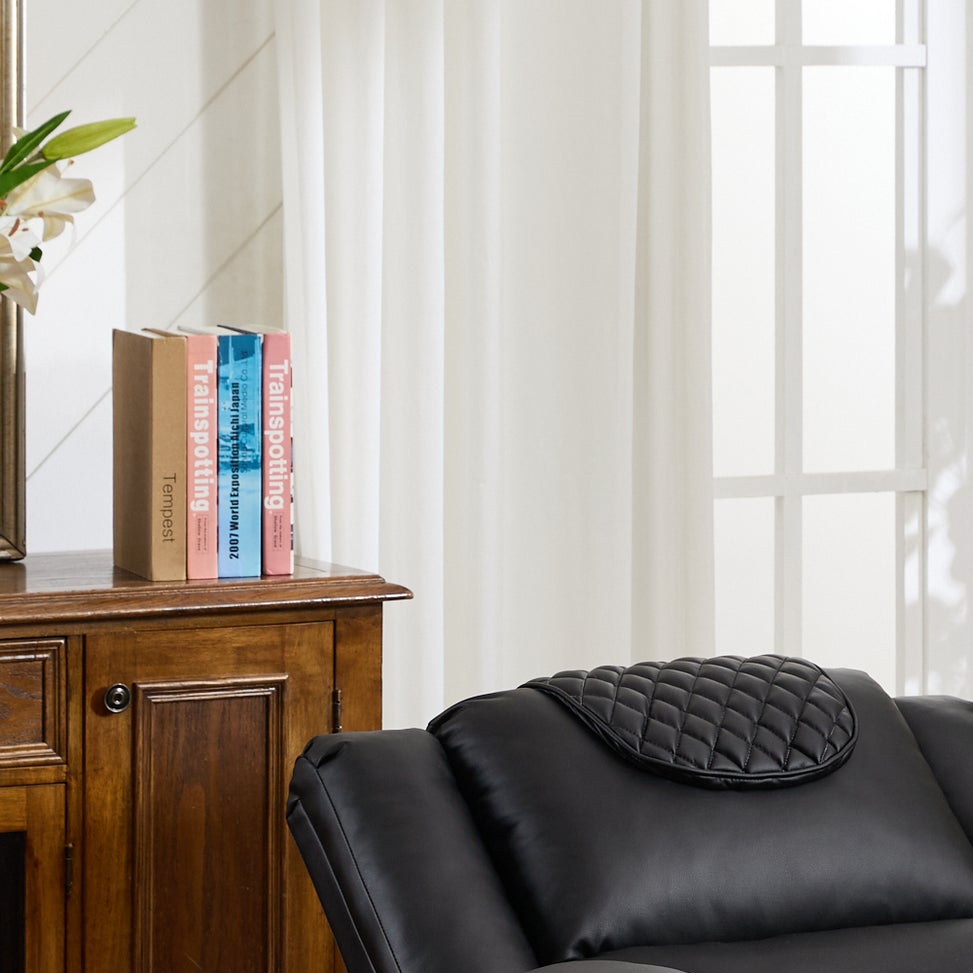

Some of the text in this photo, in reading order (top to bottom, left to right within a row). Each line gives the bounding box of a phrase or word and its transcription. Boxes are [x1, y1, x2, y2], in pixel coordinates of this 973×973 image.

[160, 473, 177, 543] Tempest
[229, 382, 240, 560] 2007 World Exposition Aichi Japan
